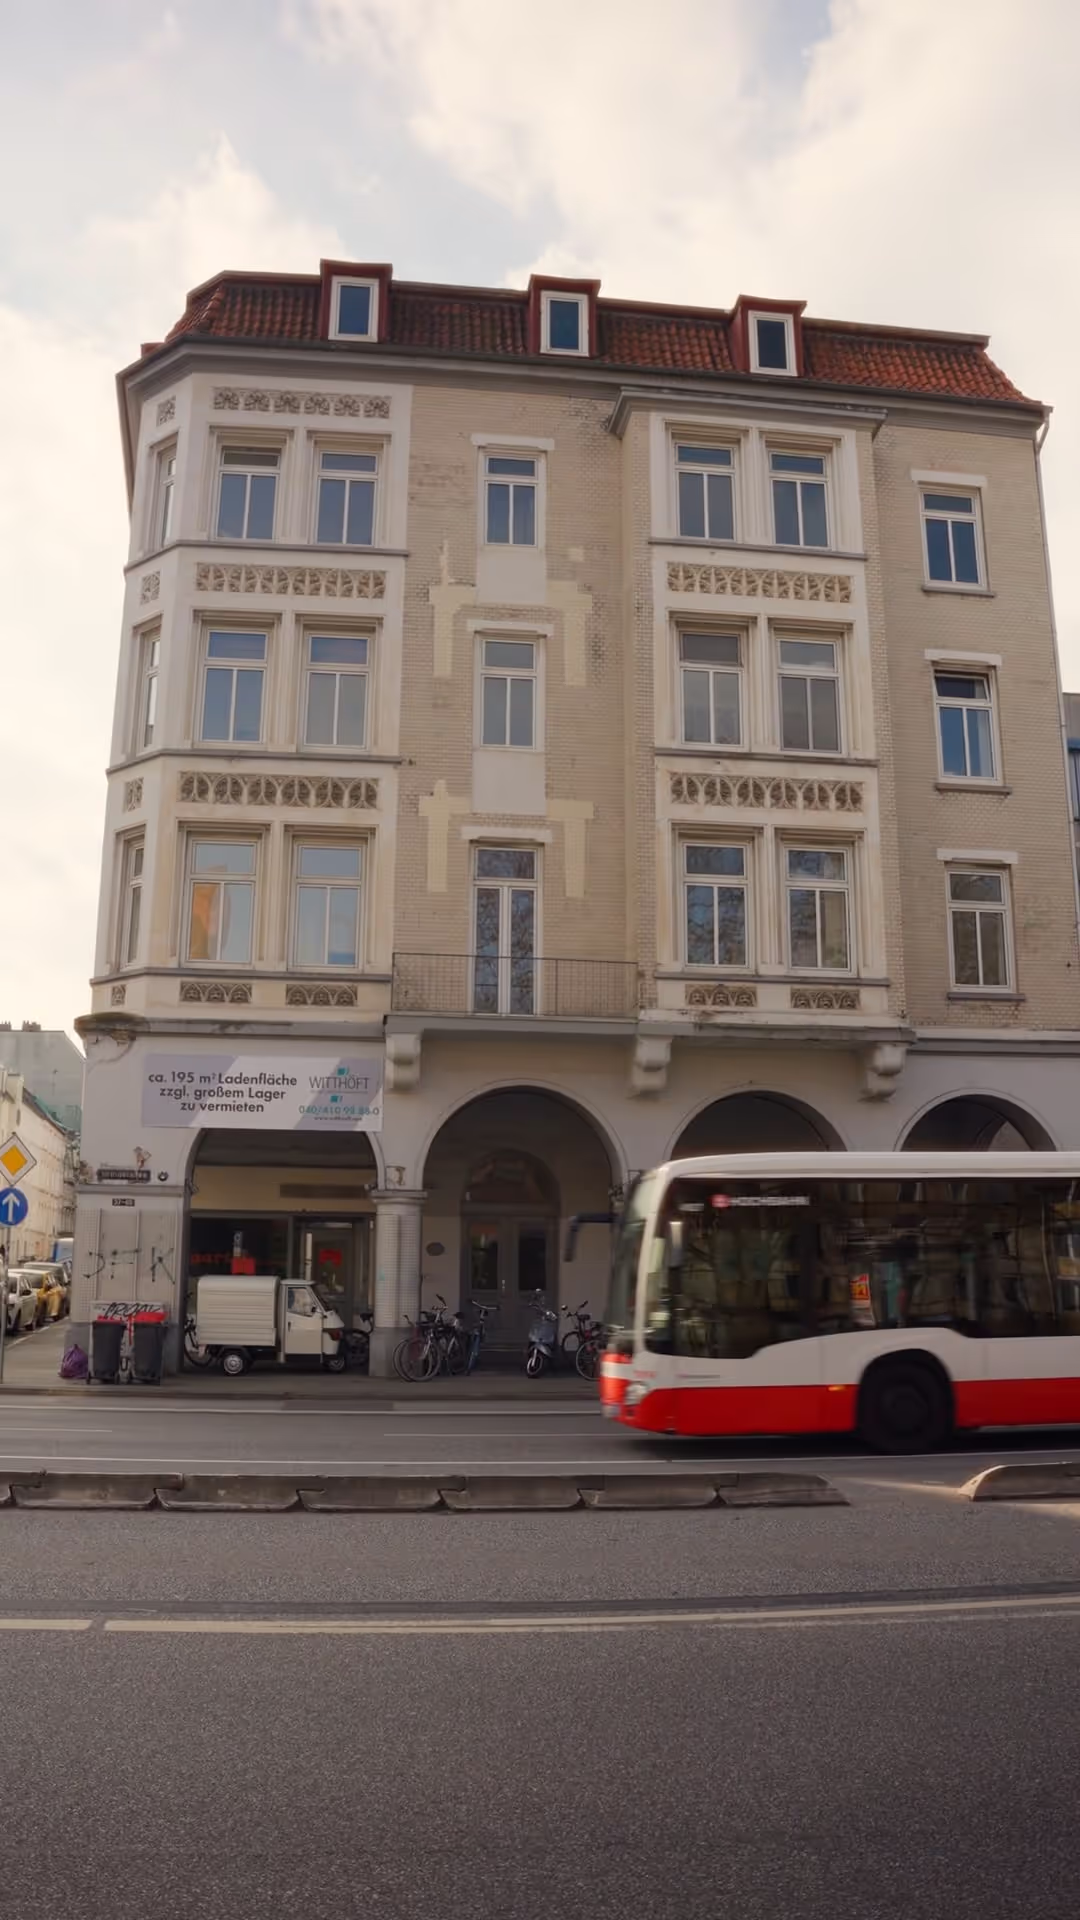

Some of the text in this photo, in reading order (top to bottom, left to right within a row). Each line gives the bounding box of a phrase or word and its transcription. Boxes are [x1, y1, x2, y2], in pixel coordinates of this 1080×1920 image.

[148, 1071, 297, 1086] ca. 195 m² Ladenfläche
[309, 1074, 370, 1089] WITTHÖFT
[159, 1085, 287, 1102] zzgl. großem Lager
[180, 1100, 264, 1112] zu vermieten
